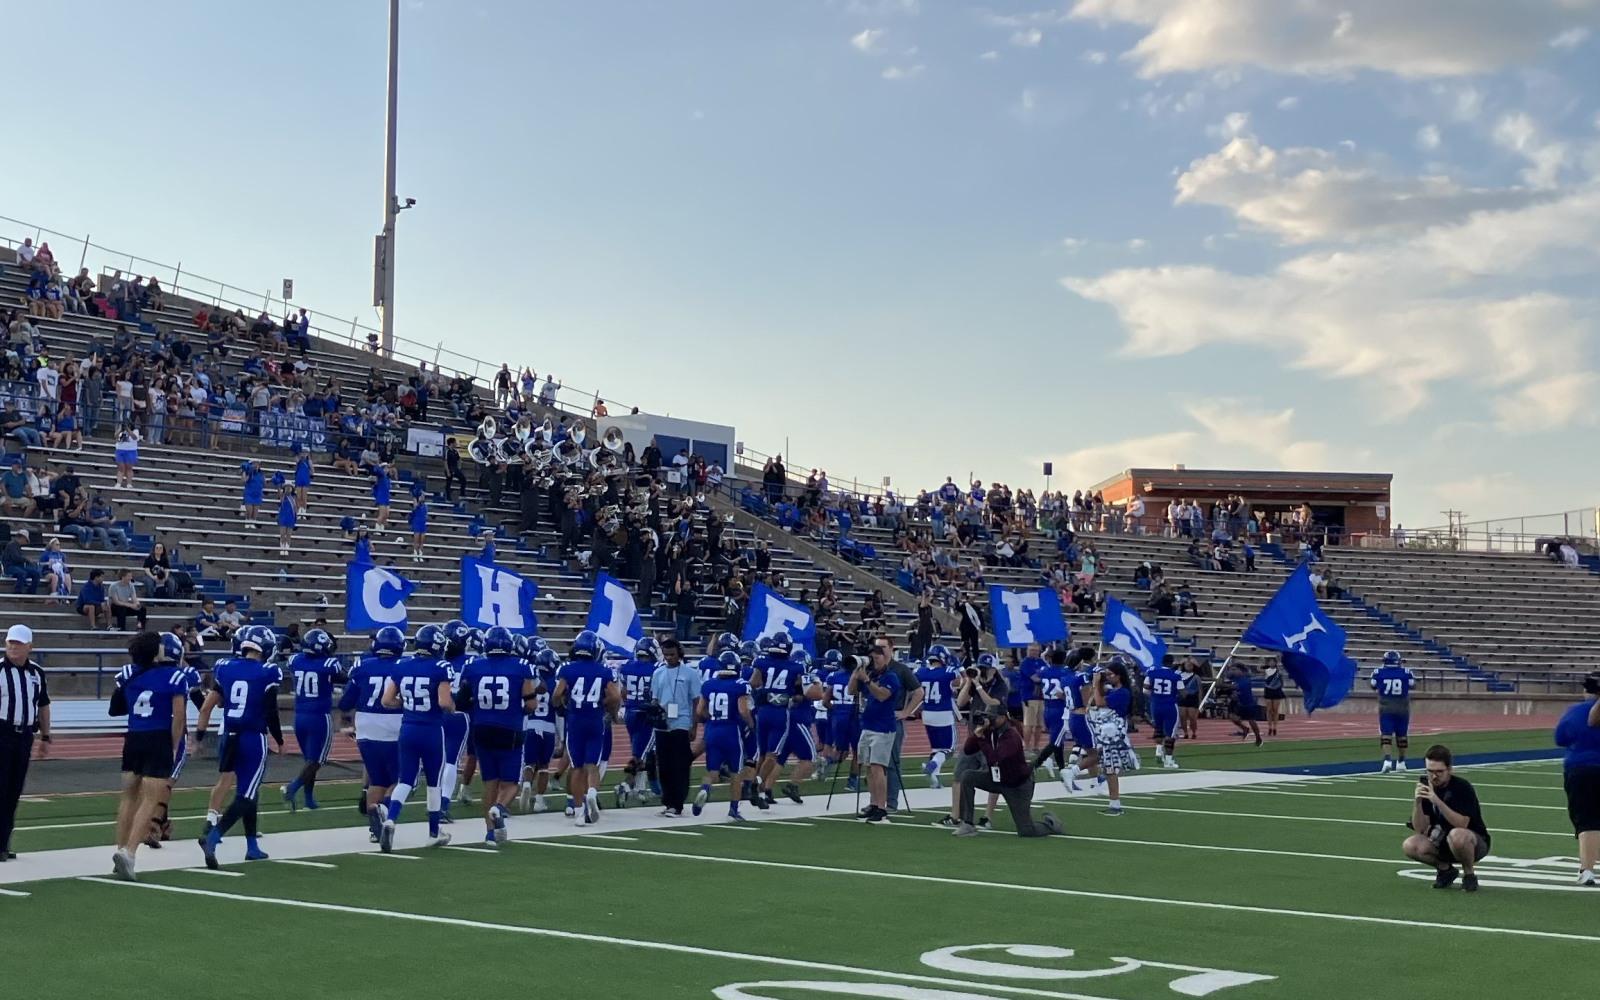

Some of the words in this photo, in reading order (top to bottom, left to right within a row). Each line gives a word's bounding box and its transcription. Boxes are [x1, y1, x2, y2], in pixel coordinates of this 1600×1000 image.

[362, 566, 407, 624] C
[475, 564, 525, 629] H
[596, 581, 638, 653] I
[1001, 590, 1040, 644] F
[1109, 611, 1158, 667] S
[294, 670, 319, 698] 70
[367, 676, 397, 706] 7
[400, 676, 431, 712] 65
[478, 676, 509, 710] 63
[571, 676, 602, 708] 44
[764, 667, 788, 689] 14
[921, 681, 942, 704] 74
[1042, 678, 1063, 700] 22
[1153, 678, 1172, 695] 53
[133, 690, 154, 717] 4
[227, 680, 248, 718] 9
[708, 692, 729, 720] 19
